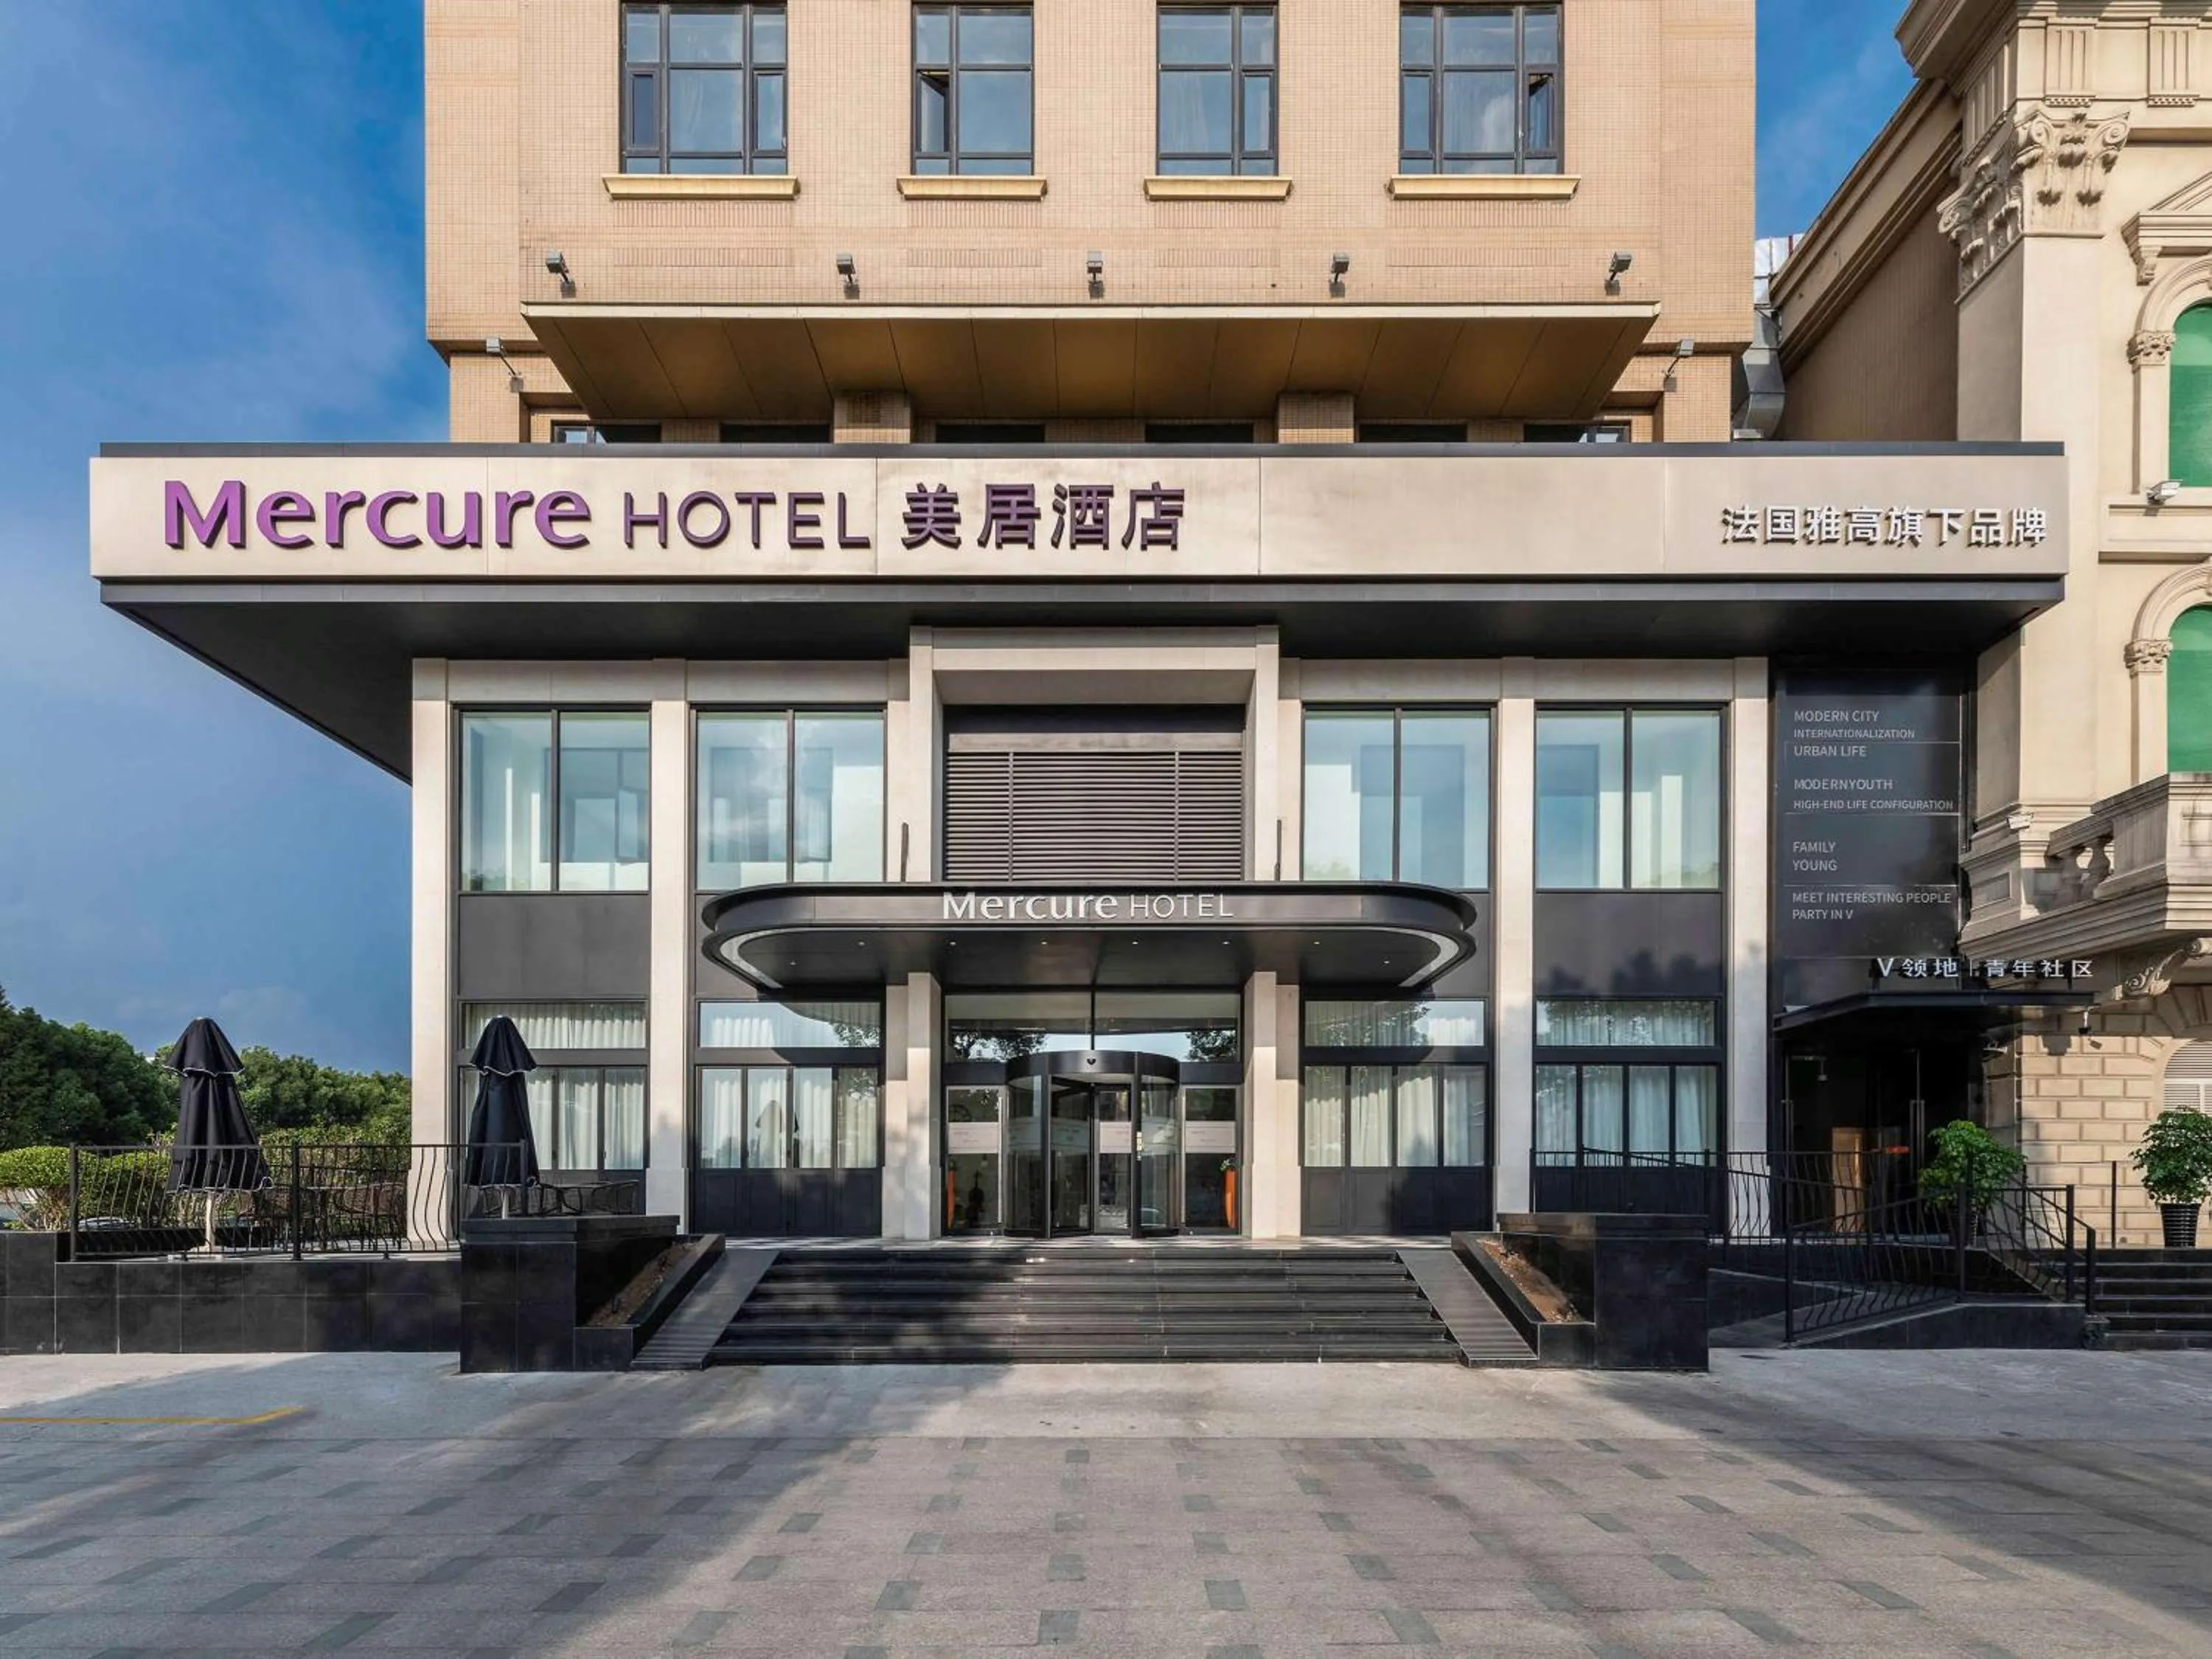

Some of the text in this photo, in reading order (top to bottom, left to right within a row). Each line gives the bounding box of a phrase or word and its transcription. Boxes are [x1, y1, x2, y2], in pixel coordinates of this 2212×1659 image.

[164, 480, 870, 550] Mercure HOTEL
[901, 481, 1185, 551] 美居酒店
[1721, 504, 2048, 548] 法国雅高旗下品牌
[1794, 710, 1879, 722] MODERN CITY
[1794, 729, 1915, 738] INTERNATIONALIZATION
[1793, 745, 1867, 757] URBAN LIFE
[1793, 800, 1953, 809] HIGH-END LIFE CONFIGURATION
[1792, 841, 1836, 852] FAMILY
[1792, 860, 1838, 871] YOUNG
[1792, 893, 1952, 903] MEET INTERESTING PEOPLE
[942, 891, 1234, 920] Mercure HOTEL
[1792, 910, 1853, 919] PARTY IN V
